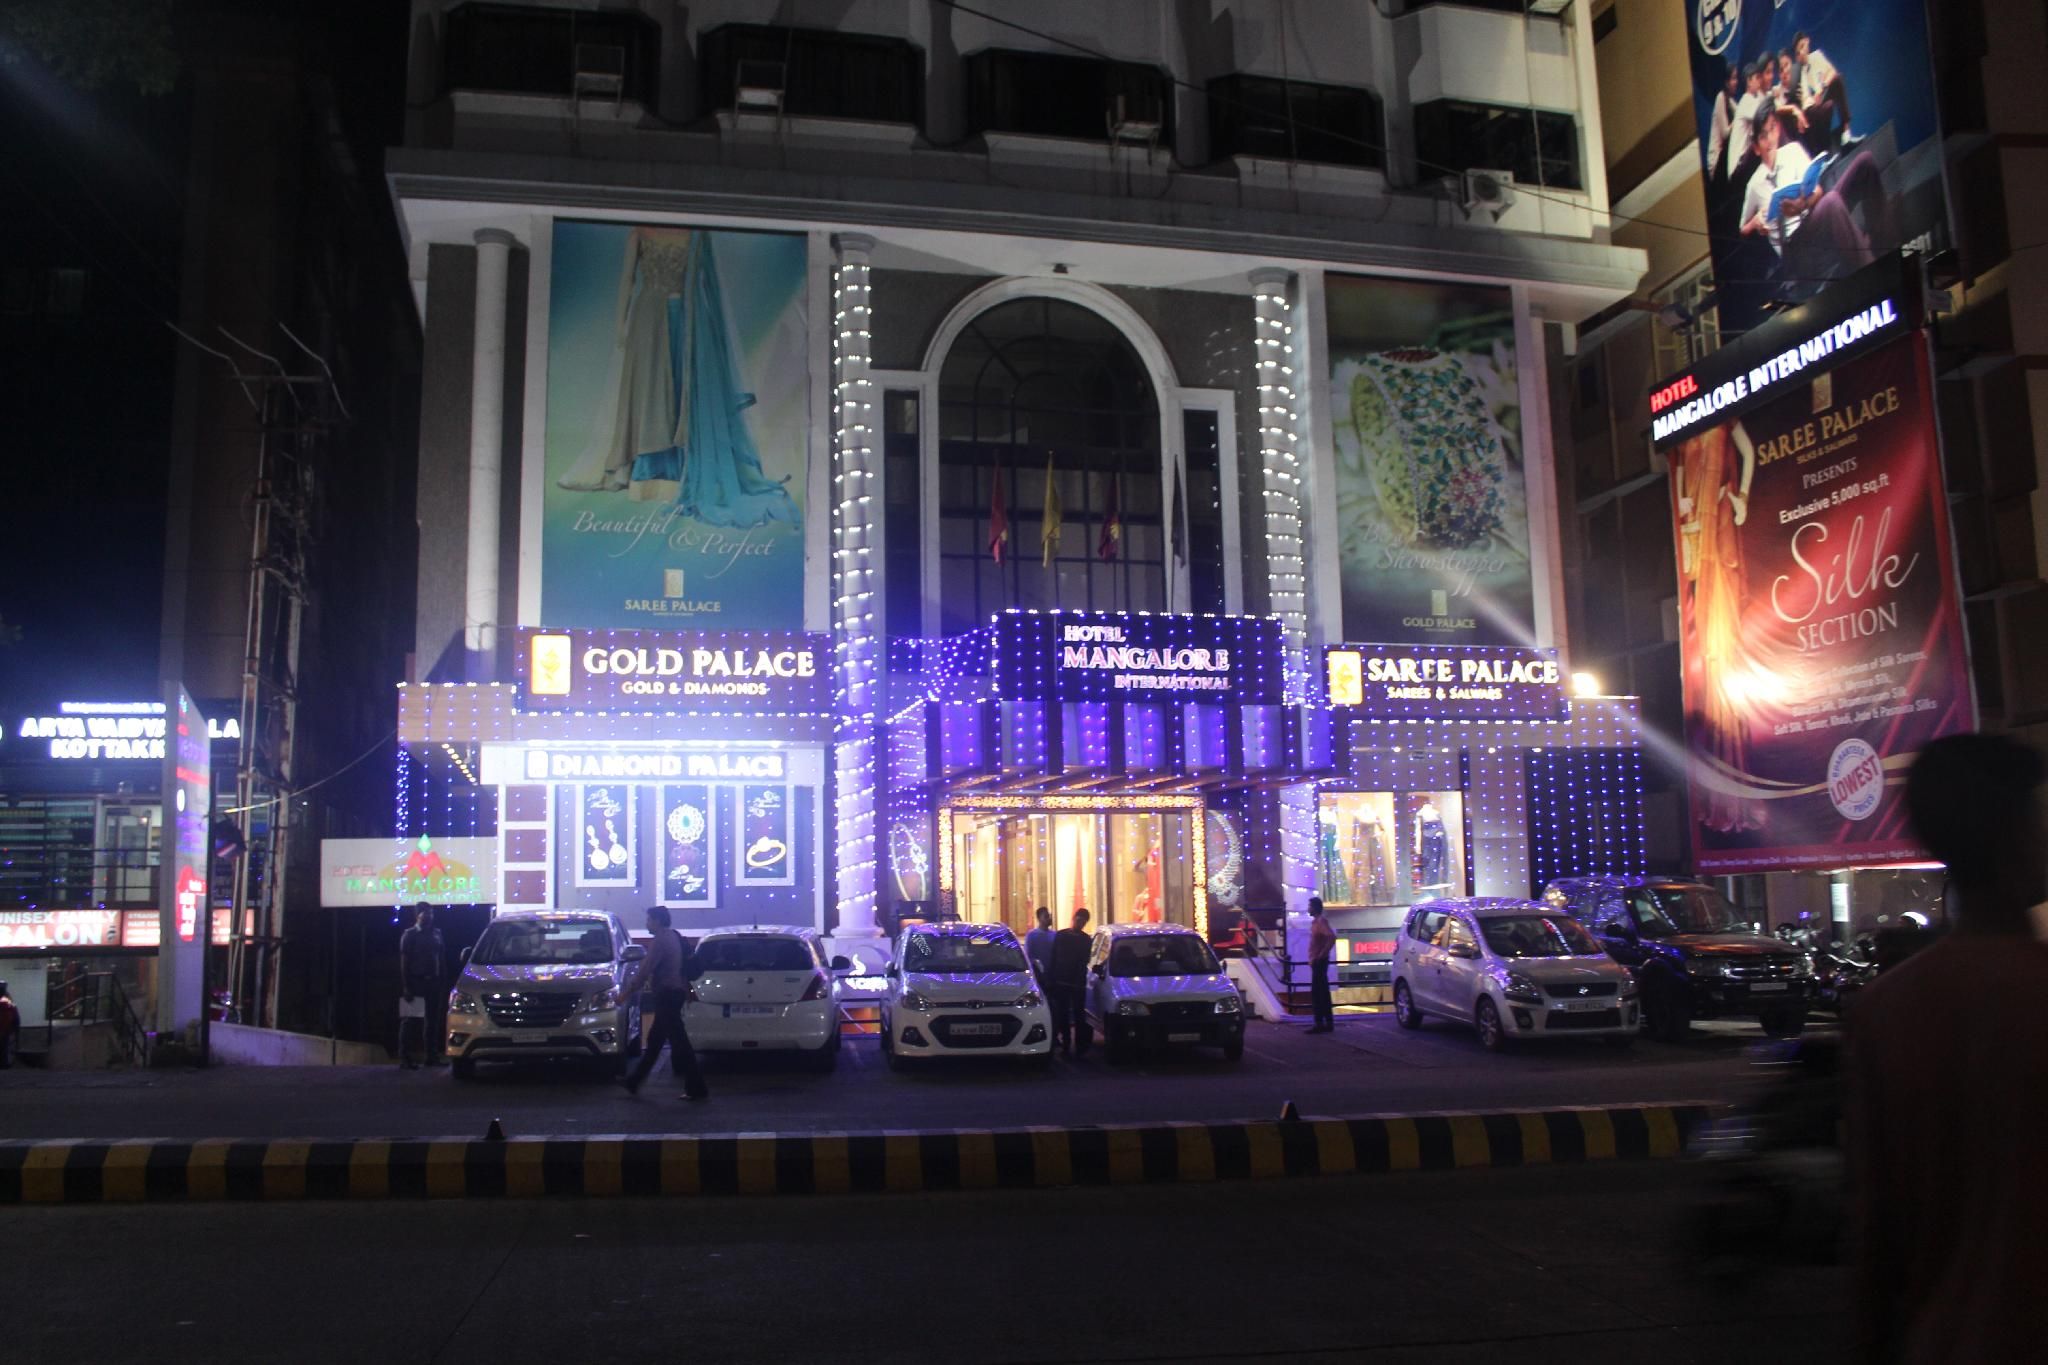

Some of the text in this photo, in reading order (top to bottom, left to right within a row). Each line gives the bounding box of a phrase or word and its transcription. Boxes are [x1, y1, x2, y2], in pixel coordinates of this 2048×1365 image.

[1652, 299, 1897, 441] MANGALORE INTERNATIONAL
[1650, 375, 1698, 413] HOTEL
[1757, 386, 1900, 466] SAREE PALACE
[1802, 456, 1858, 489] PRESENTS
[1779, 495, 1830, 524] Exclusive
[1831, 483, 1861, 505] 5,000
[573, 502, 777, 579] Beautiful & Perfect
[1771, 506, 1920, 622] Silk
[624, 599, 722, 613] SAREE PALACE
[1064, 625, 1127, 642] HOTEL
[1402, 616, 1477, 629] GOLD PALACE
[1796, 602, 1898, 651] SECTION
[583, 648, 816, 677] GOLD PALACE
[1063, 646, 1231, 672] MANGALORE
[1367, 657, 1560, 684] SAREE PALACE
[621, 681, 768, 695] GOLD & DIAMONDS
[1114, 674, 1232, 690] INTERNATIONAL
[1387, 686, 1503, 700] SAREES & SALWARS
[20, 717, 86, 738] ARYA
[50, 738, 166, 759] KOTTAKK
[552, 754, 784, 777] DIAMOND PALACE
[1831, 754, 1879, 806] LOWEST
[332, 865, 377, 877] HOTEL
[345, 876, 481, 894] MANGALORE
[58, 910, 119, 923] FAMILY
